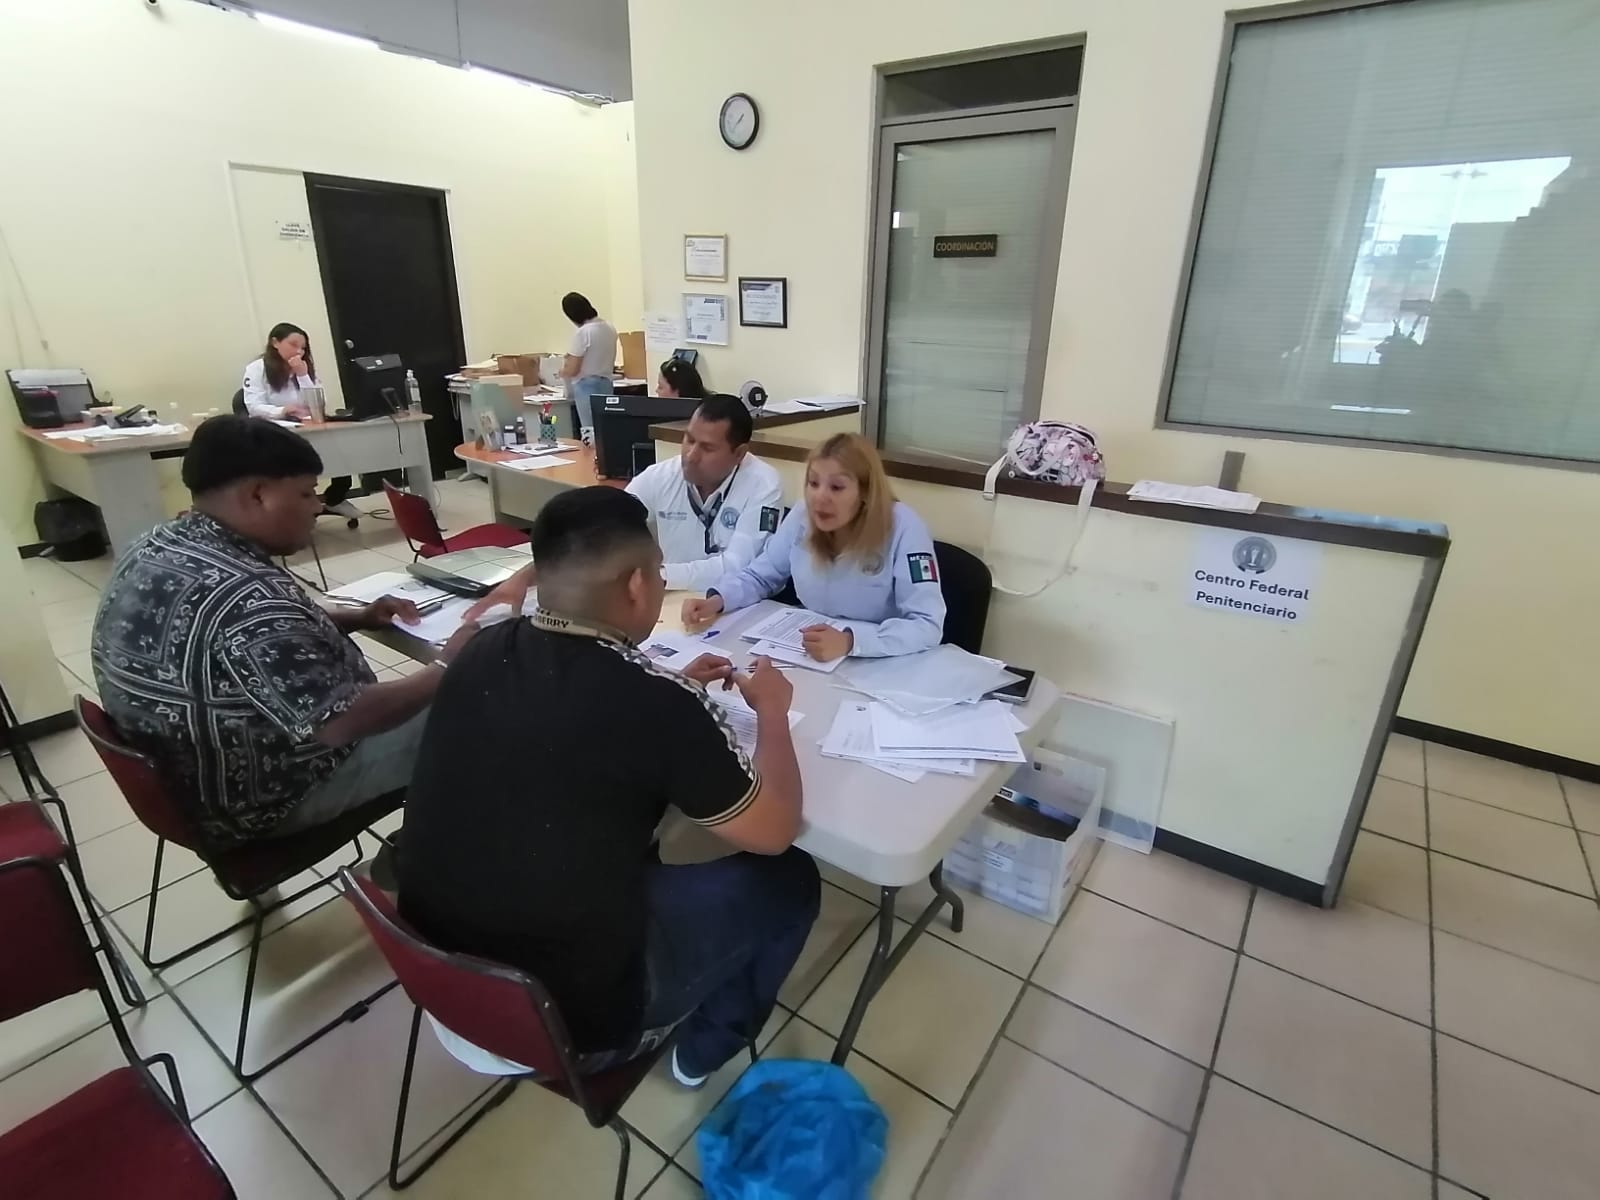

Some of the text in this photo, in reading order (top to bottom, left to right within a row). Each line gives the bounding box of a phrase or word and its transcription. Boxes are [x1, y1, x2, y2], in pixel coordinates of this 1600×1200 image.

[1194, 570, 1309, 600] Centro Federal
[1196, 590, 1297, 619] Penitenciario
